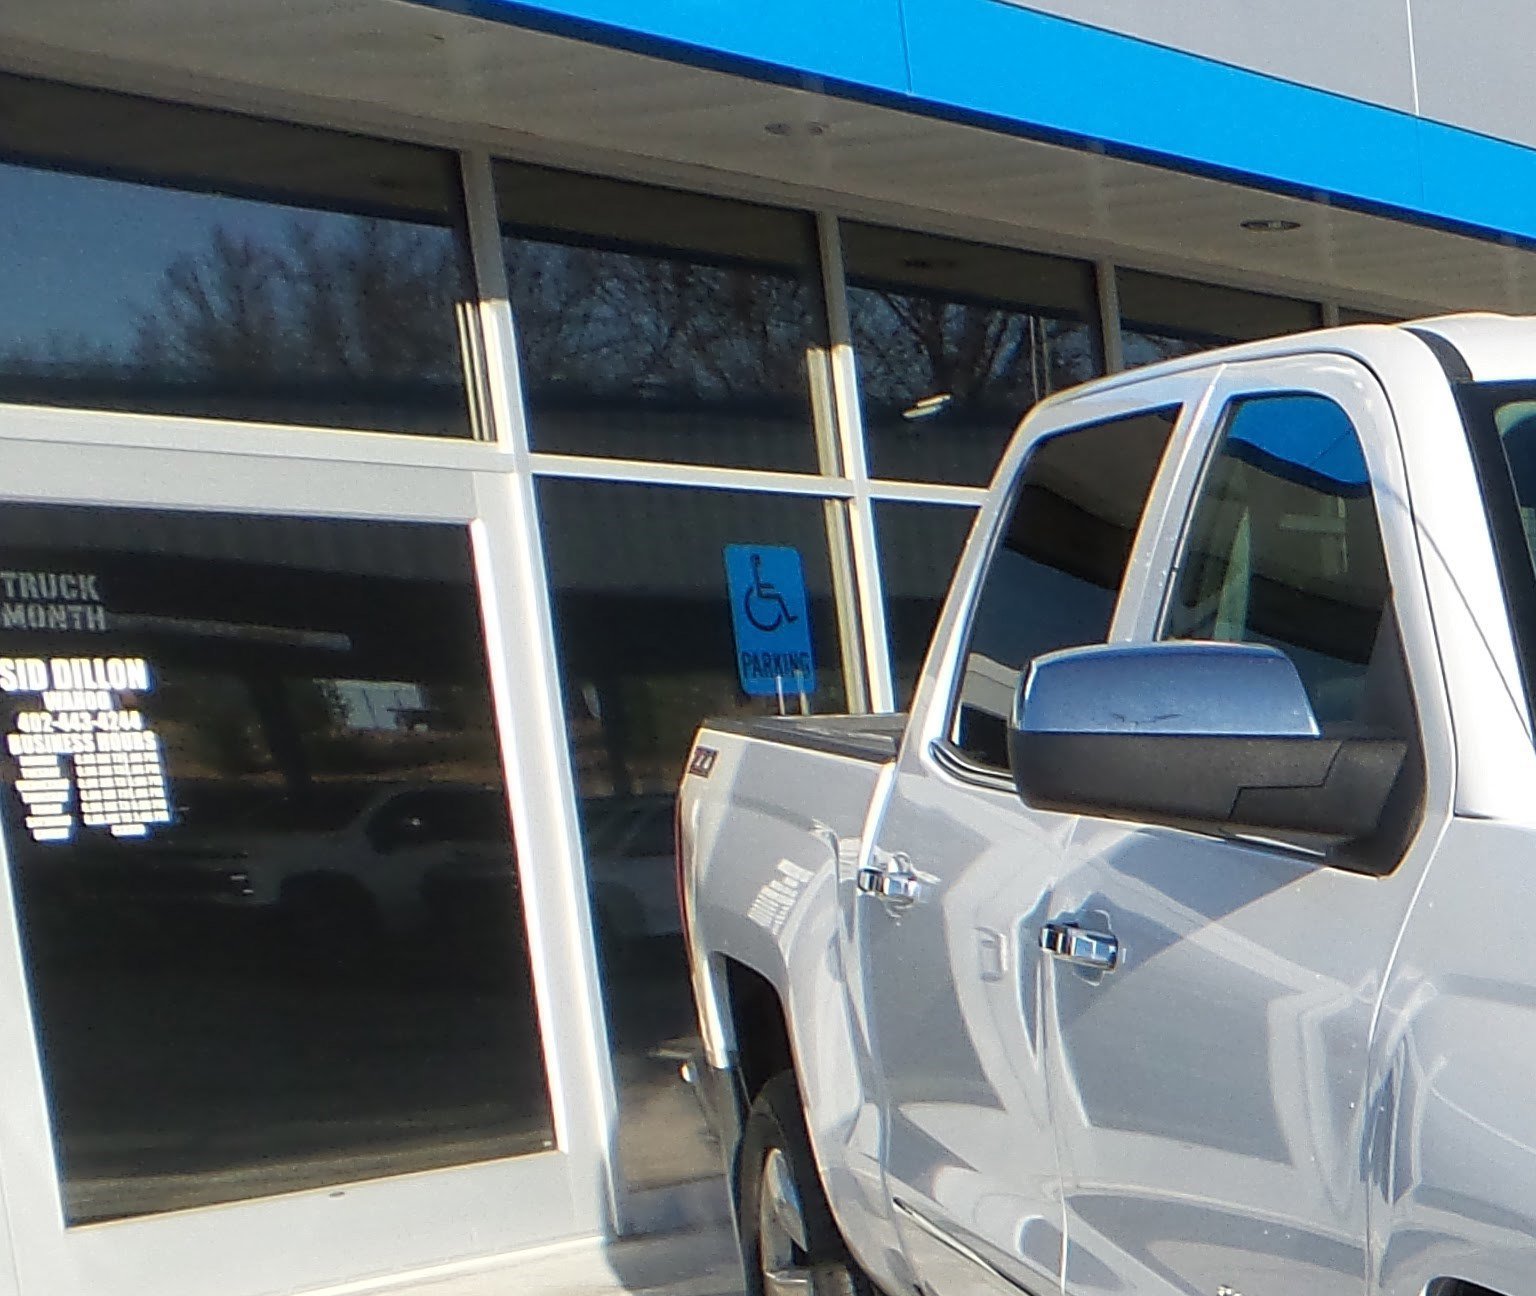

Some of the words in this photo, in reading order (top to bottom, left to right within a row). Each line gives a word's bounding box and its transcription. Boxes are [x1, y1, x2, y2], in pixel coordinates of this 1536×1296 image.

[1, 572, 100, 601] TRUCK
[1, 602, 107, 632] MONTH
[0, 657, 49, 692] SID
[51, 657, 149, 691] DILLON
[741, 651, 811, 679] PARKING
